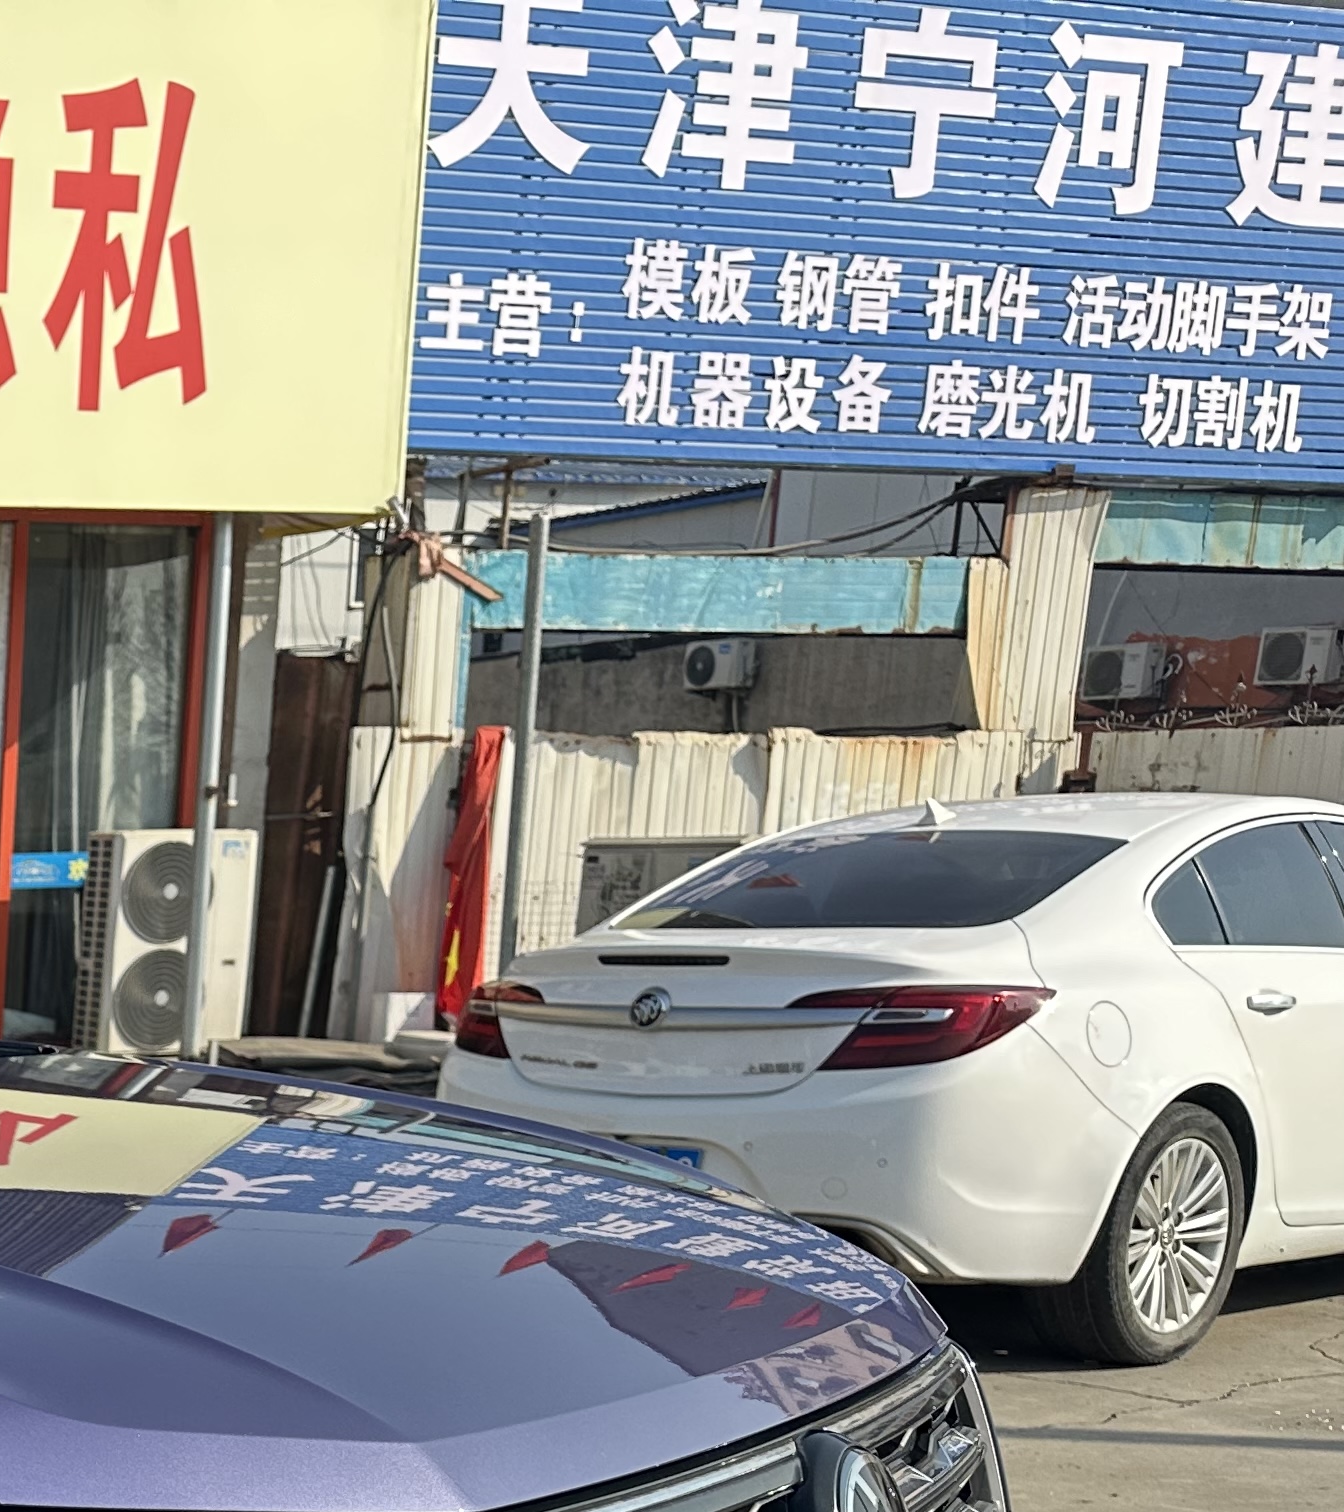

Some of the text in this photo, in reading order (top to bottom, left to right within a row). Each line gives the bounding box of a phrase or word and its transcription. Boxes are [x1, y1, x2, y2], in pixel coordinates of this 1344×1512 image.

[622, 237, 1332, 361] 模板 钢管 扣件 活动脚手架
[617, 346, 1303, 454] 机器设备 磨光机 切割机
